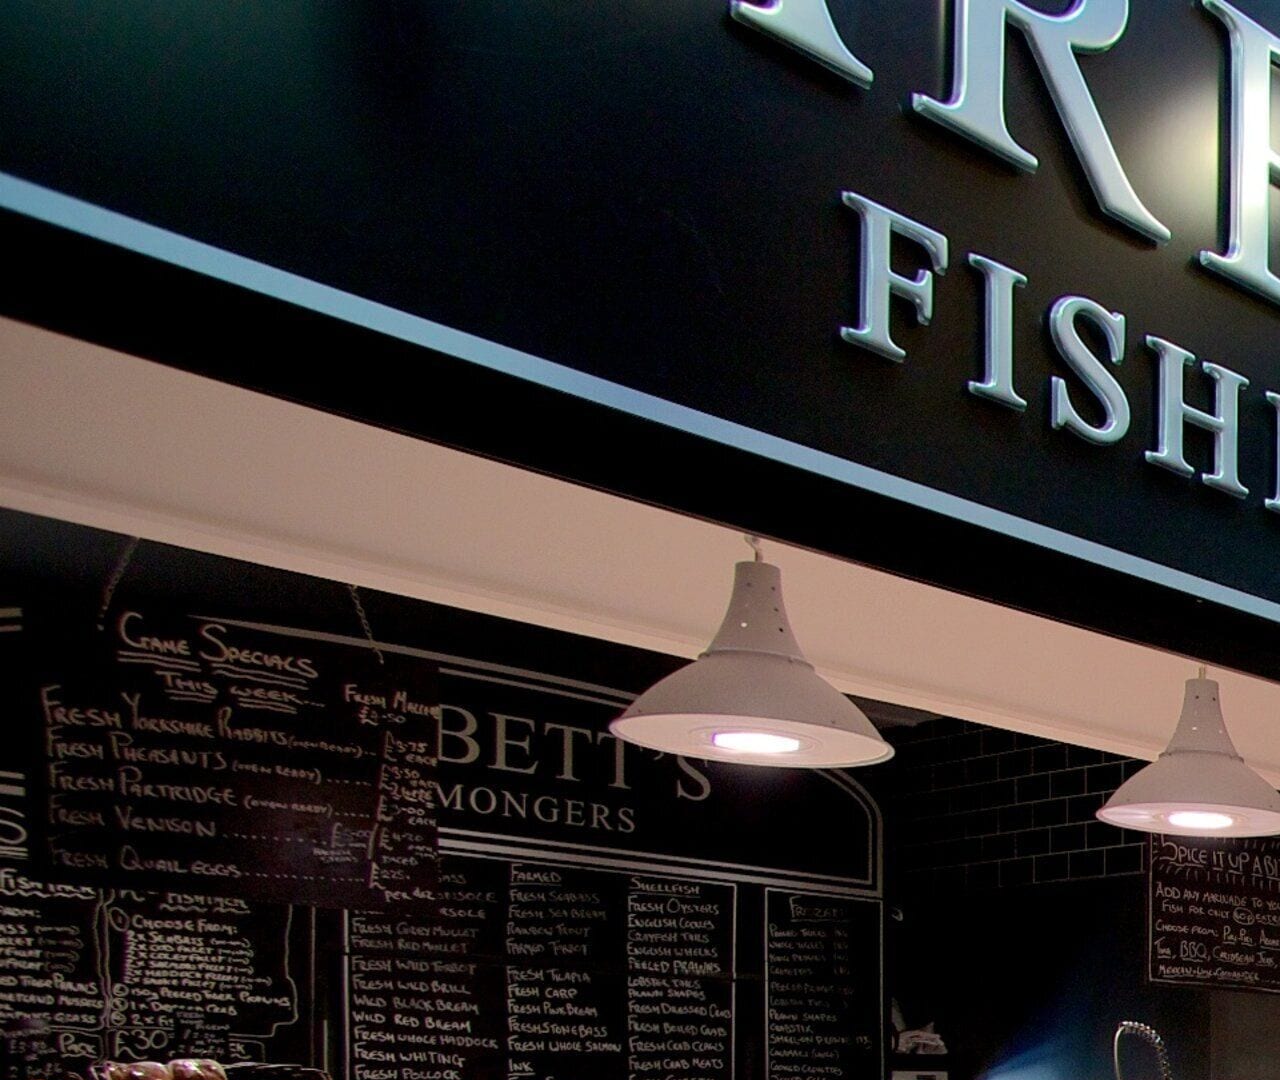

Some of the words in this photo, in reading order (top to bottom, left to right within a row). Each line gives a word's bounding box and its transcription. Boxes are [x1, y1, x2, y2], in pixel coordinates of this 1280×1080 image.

[117, 610, 191, 655] GAME
[199, 623, 319, 678] SPECIALS
[154, 670, 218, 695] THIS
[42, 683, 122, 729] FRESH
[121, 691, 215, 739] YORKSHIRE
[43, 725, 105, 760] FRESH
[106, 730, 228, 770] PHEASANTS
[48, 760, 115, 792] FRESH
[118, 764, 238, 806] PARTRIDGE
[48, 792, 107, 827] FRESH
[113, 803, 217, 838] VENISON
[119, 843, 188, 874] QUAIL
[191, 860, 242, 879] EGGS
[1159, 834, 1208, 864] SPICE
[1212, 850, 1225, 868] IT
[1227, 851, 1250, 874] UP
[1252, 855, 1264, 875] A
[510, 863, 563, 883] FARMED
[629, 876, 700, 895] SHELLFISH
[1155, 881, 1180, 899] ADD
[1250, 897, 1263, 908] TO
[627, 895, 665, 914] FRESH
[666, 897, 720, 915] OYSTERS
[1162, 899, 1184, 914] FISH
[1188, 905, 1206, 915] FOR
[131, 913, 195, 931] CHOOSE
[351, 917, 393, 935] FRESH
[351, 973, 394, 990] FRESH
[397, 981, 430, 993] WILD
[431, 979, 472, 995] BRILL
[506, 965, 545, 984] FRESH
[507, 983, 540, 999] FRESH
[544, 987, 579, 999] CARP
[353, 993, 388, 1008] WILD
[435, 999, 481, 1016] BREAM
[352, 1011, 387, 1024] WILD
[393, 1013, 421, 1028] RED
[424, 1016, 473, 1033] BREAM
[353, 1025, 396, 1044] FRESH
[397, 1034, 438, 1046] WHOLE
[440, 1034, 500, 1050] HADDOCK
[507, 1035, 545, 1052] FRESH
[548, 1040, 582, 1052] WHOLE
[585, 1040, 622, 1053] SALMON
[353, 1042, 397, 1063] FRESH
[399, 1051, 466, 1069] WHITING
[508, 1058, 534, 1073] INK
[628, 1055, 662, 1071] FRESH
[692, 1057, 725, 1070] MEATS
